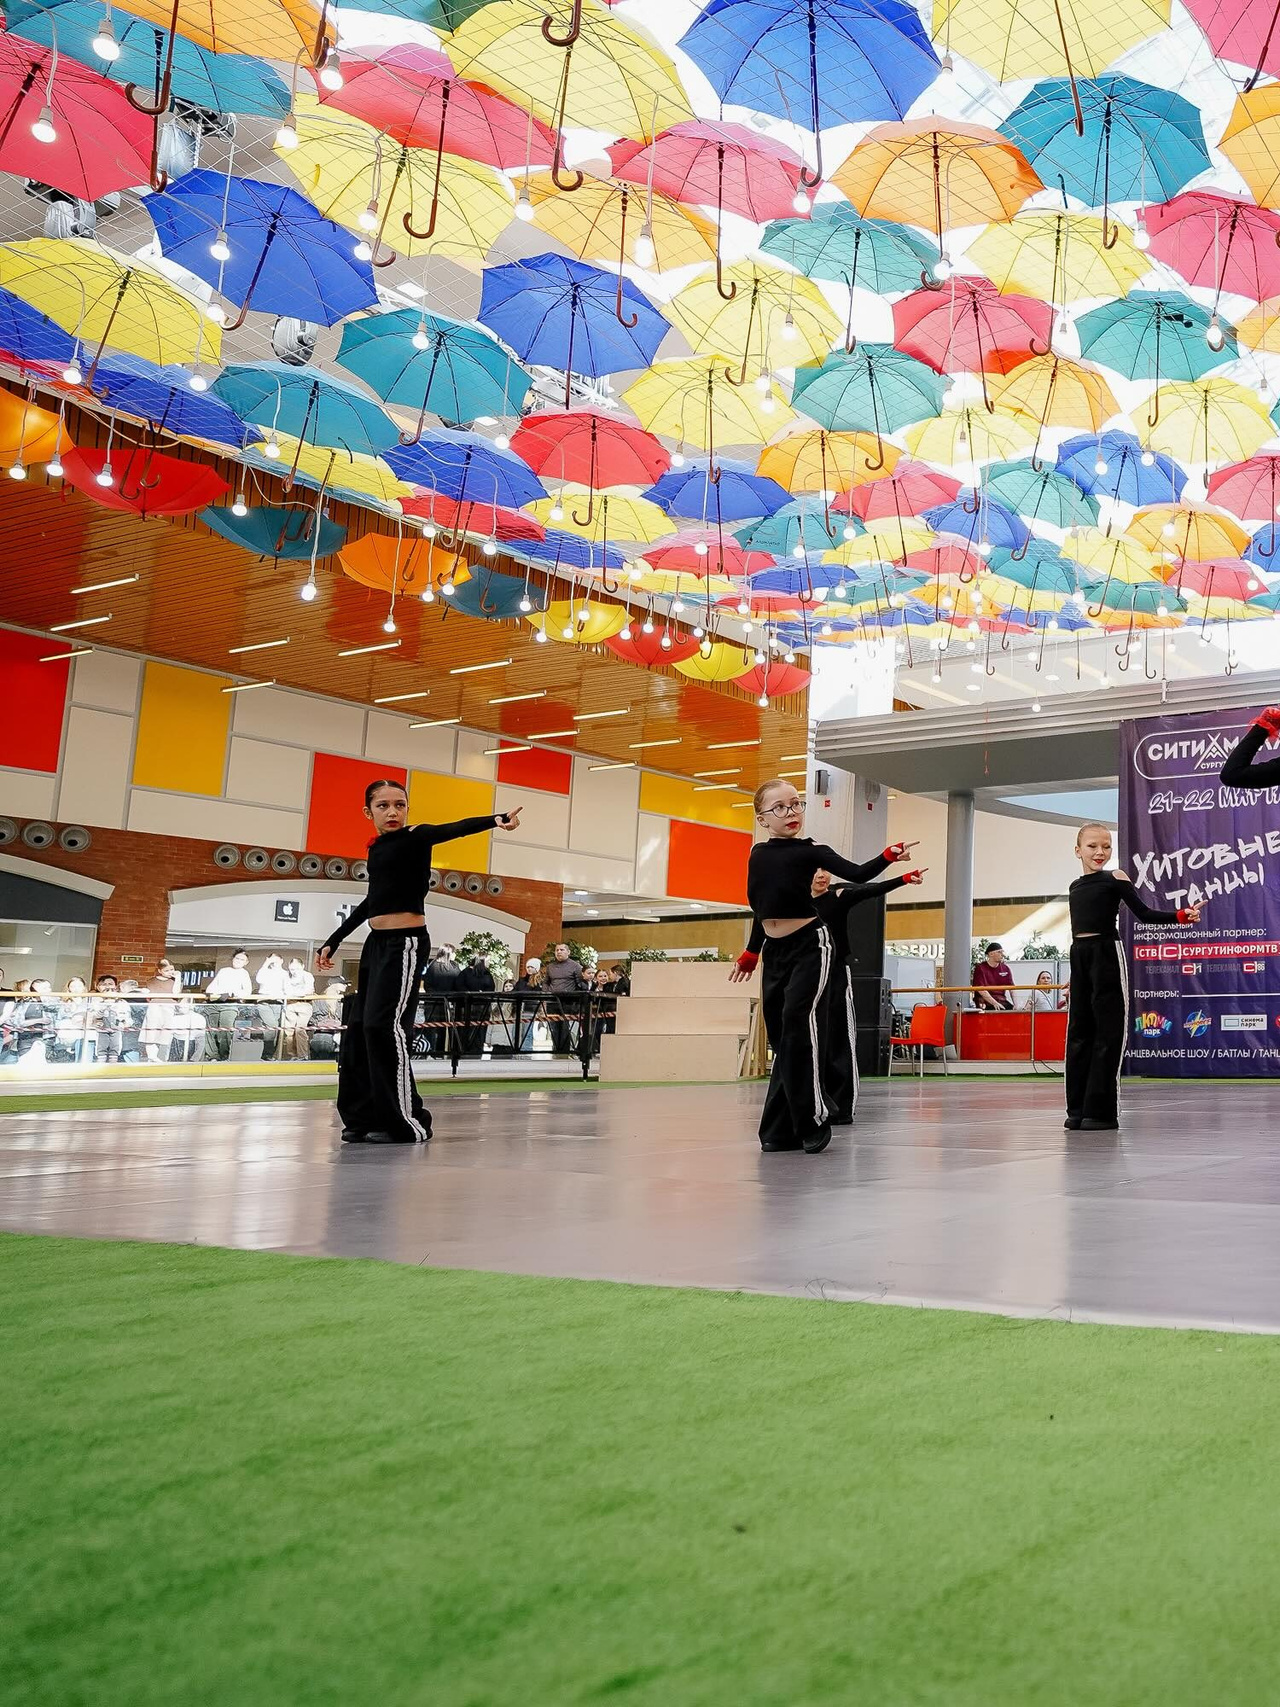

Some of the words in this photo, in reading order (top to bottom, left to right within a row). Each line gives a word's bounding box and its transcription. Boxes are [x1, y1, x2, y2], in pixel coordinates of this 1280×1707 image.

[1148, 788, 1215, 814] 21-22
[1165, 862, 1265, 910] ТАНЦЫ
[1133, 928, 1221, 941] информационный
[1222, 928, 1267, 938] партнер:
[1134, 989, 1180, 1000] Партнеры:
[1143, 1028, 1161, 1037] парк
[1187, 1049, 1210, 1058] ШОУ
[1217, 1048, 1250, 1058] БАТТЛЫ
